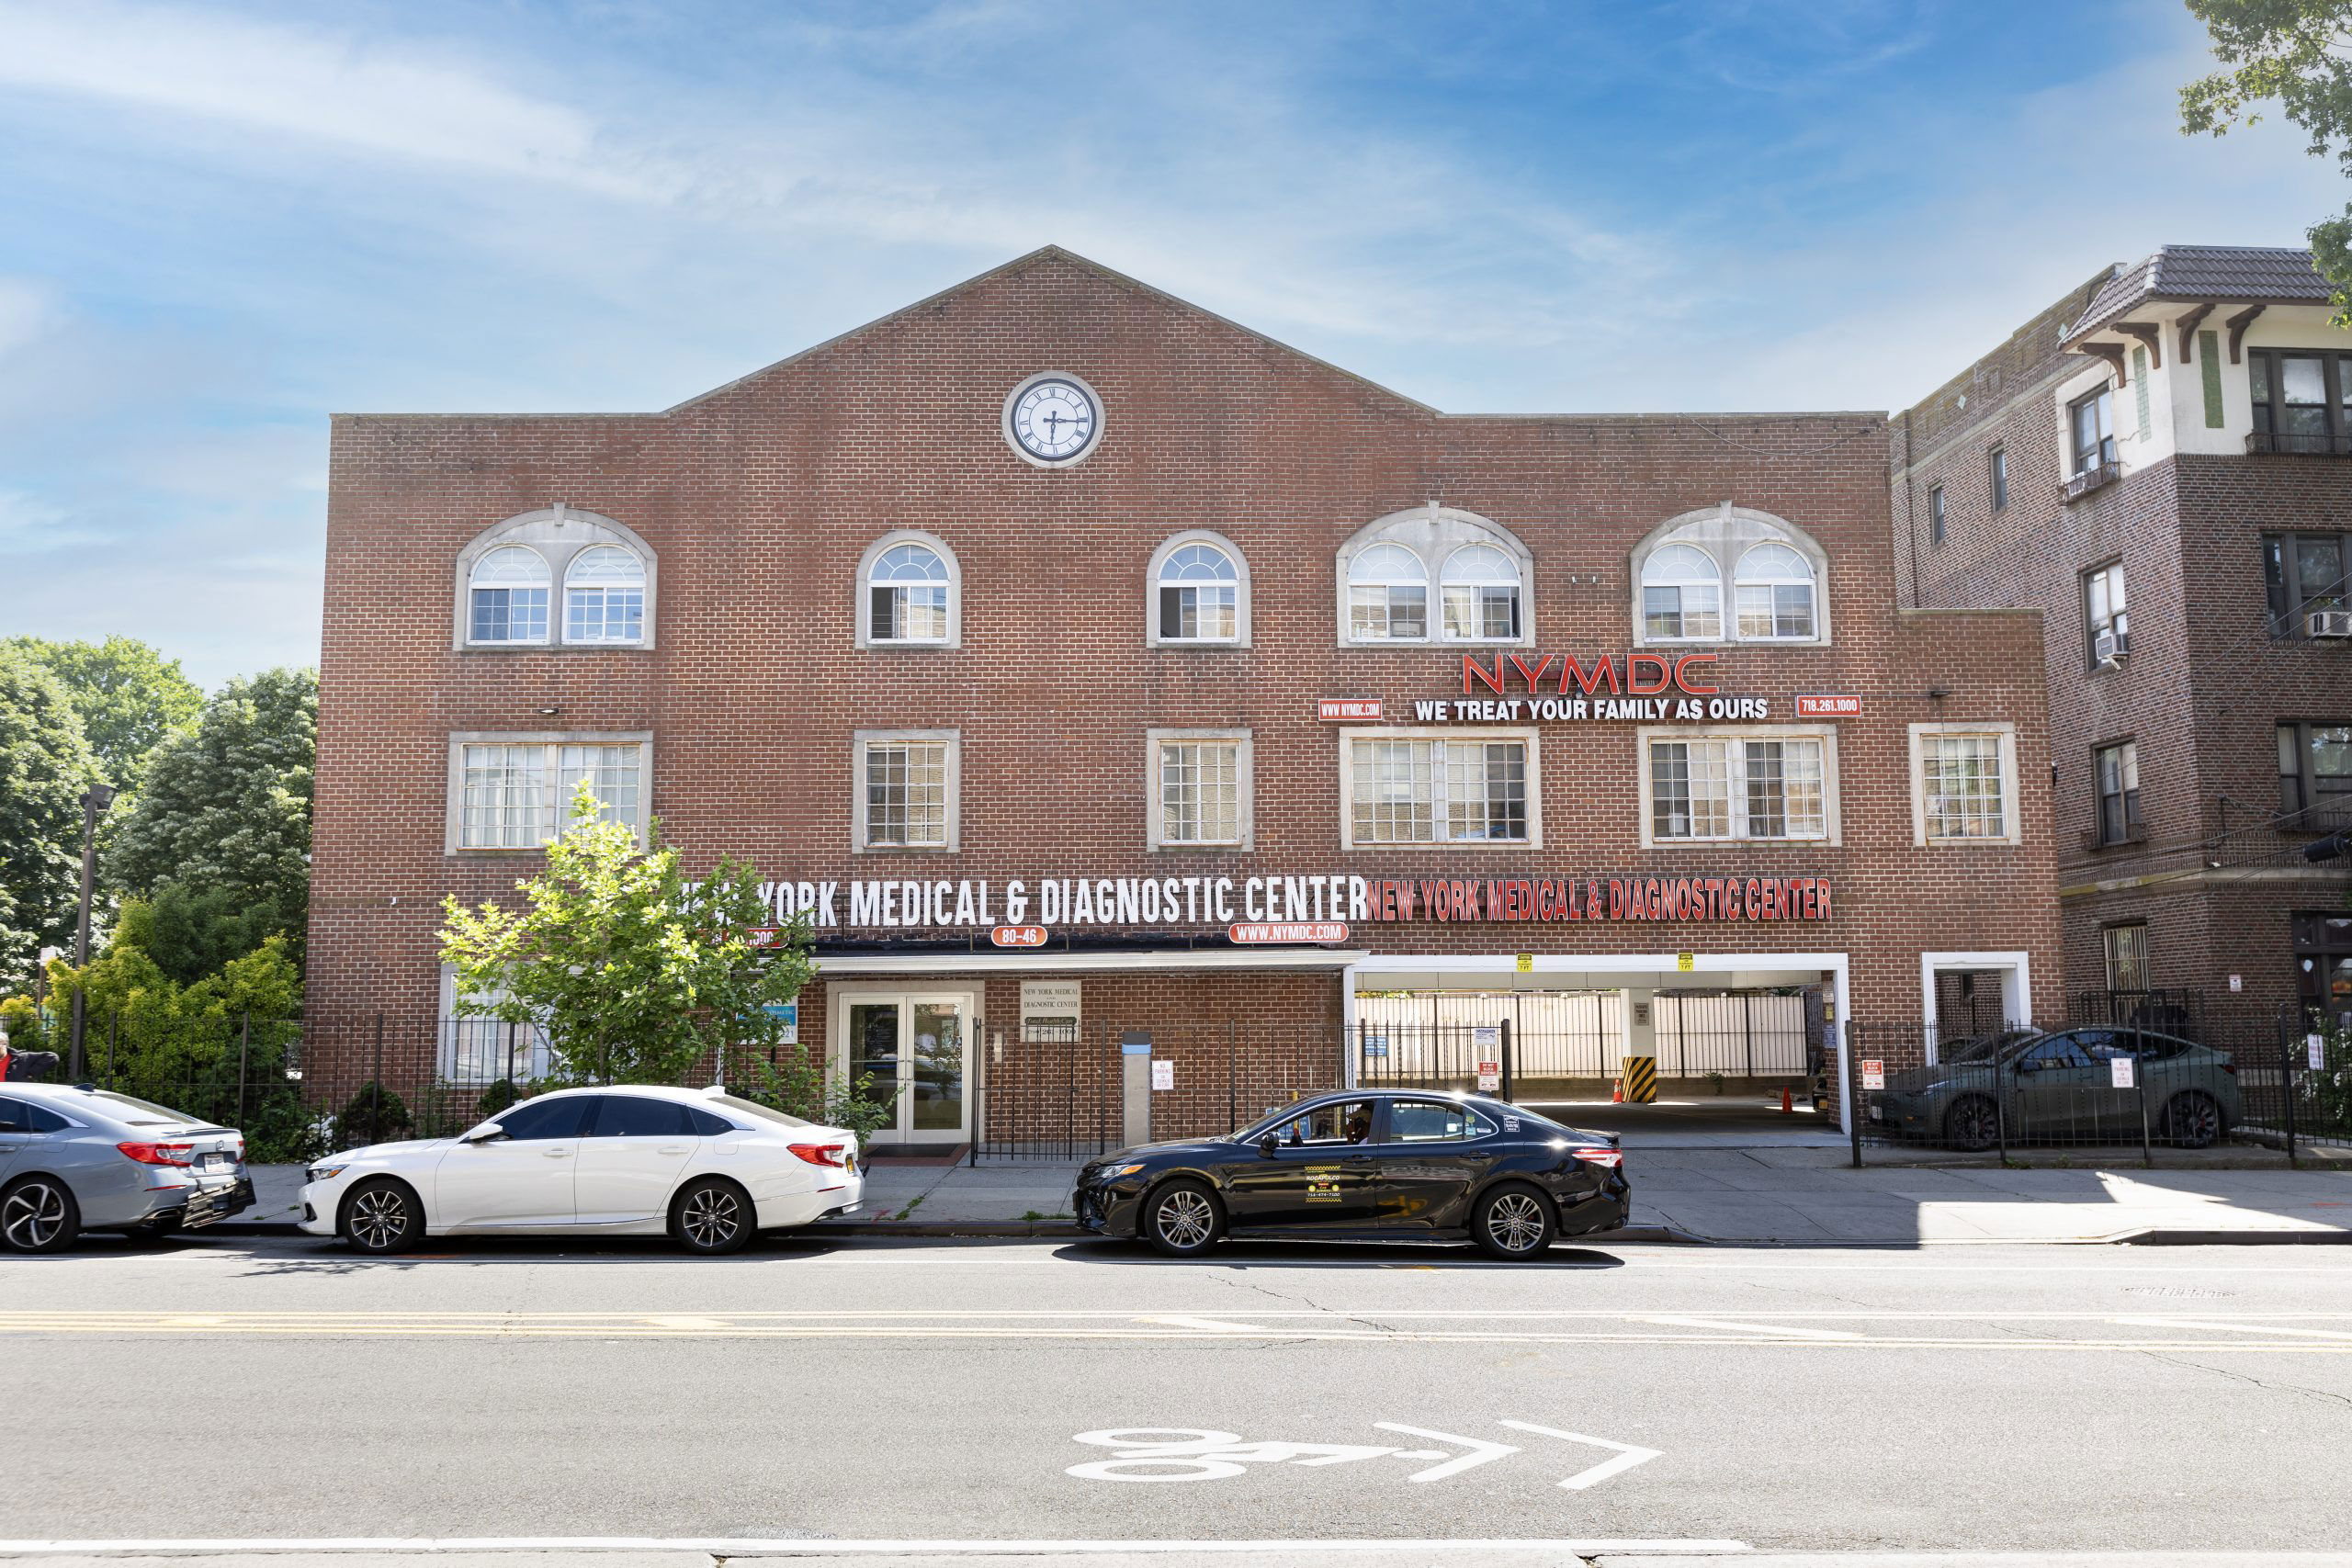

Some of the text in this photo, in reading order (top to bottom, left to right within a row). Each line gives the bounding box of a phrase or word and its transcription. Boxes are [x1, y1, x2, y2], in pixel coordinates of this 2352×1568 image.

[1463, 653, 1719, 694] NYMDC
[1415, 697, 1768, 720] WE TREAT YOUR FAMILY AS OURS
[1802, 699, 1857, 712] 718.261.1000
[757, 881, 838, 927] YORK
[850, 880, 995, 926] MEDICAL
[1006, 879, 1029, 925] &
[1041, 877, 1234, 925] DIAGNOSTIC
[1245, 876, 1367, 922] CENTER
[1366, 878, 1832, 921] NEW YORK MEDICAL & DIAGNOSTIC CENTER
[1001, 929, 1037, 943] 80-46
[1236, 924, 1342, 942] WWW.NYMDC.COM
